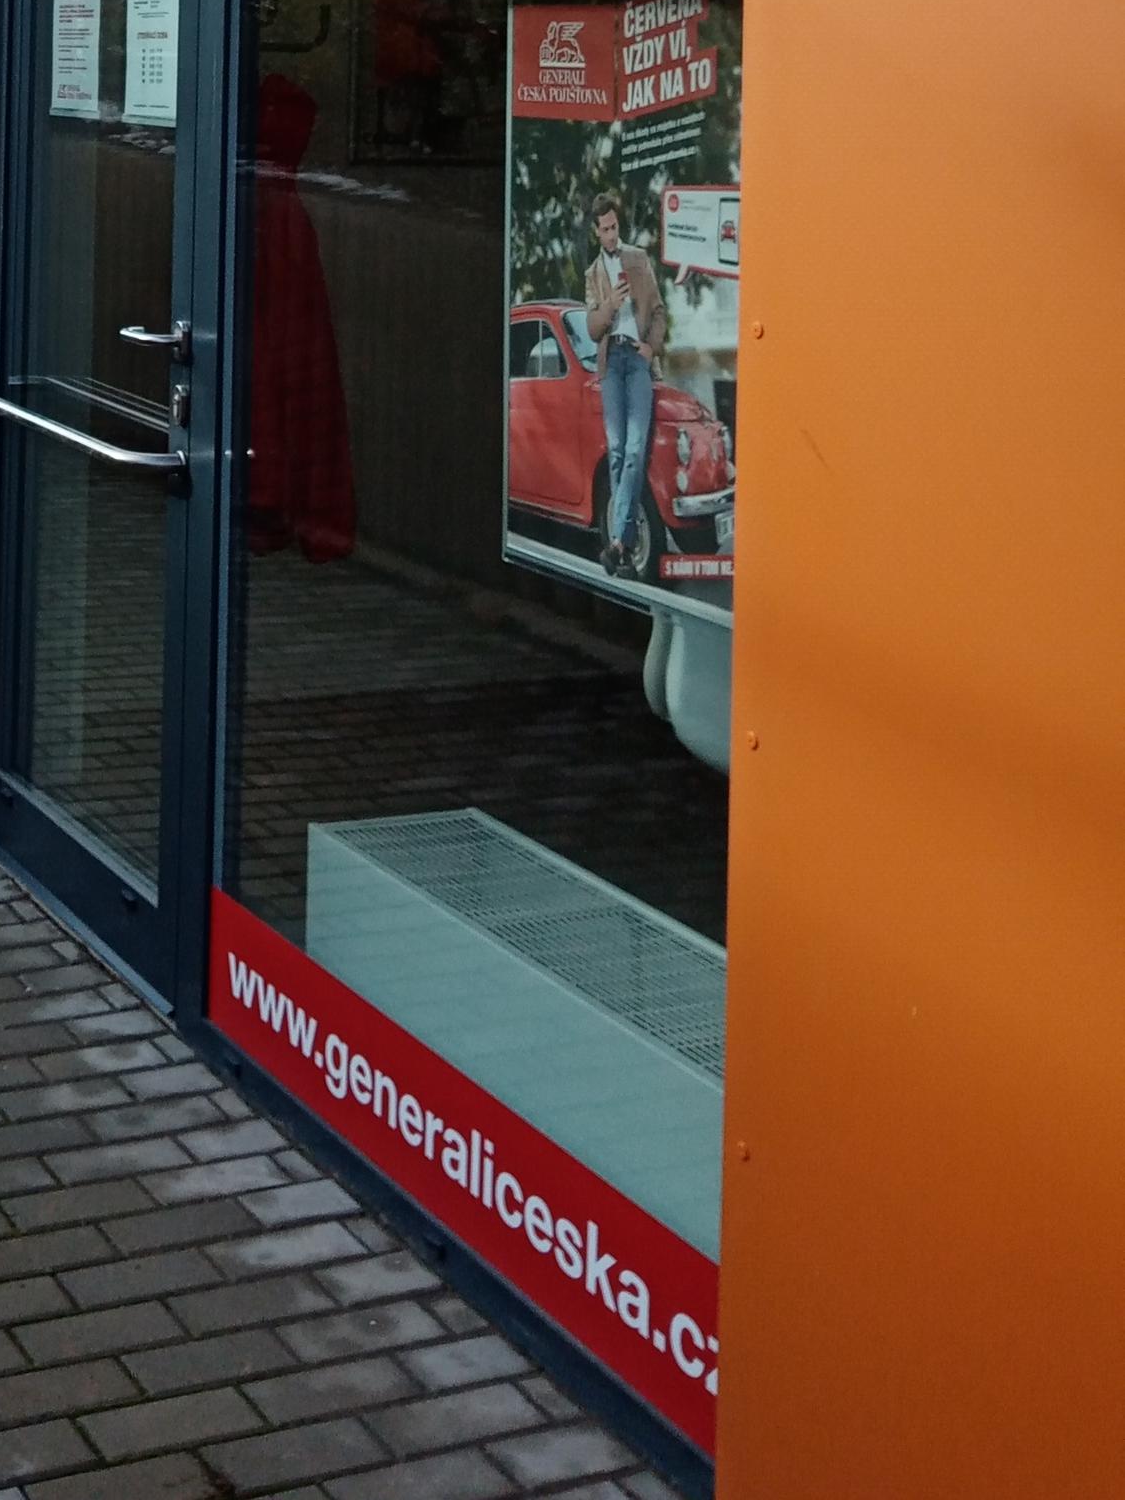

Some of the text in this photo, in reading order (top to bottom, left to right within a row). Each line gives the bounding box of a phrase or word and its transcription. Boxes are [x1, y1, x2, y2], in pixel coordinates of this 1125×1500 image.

[622, 33, 667, 76] VŽDY
[517, 83, 547, 102] ČESKÁ
[538, 68, 586, 86] GENERALI
[622, 57, 712, 113] JAK NA TO
